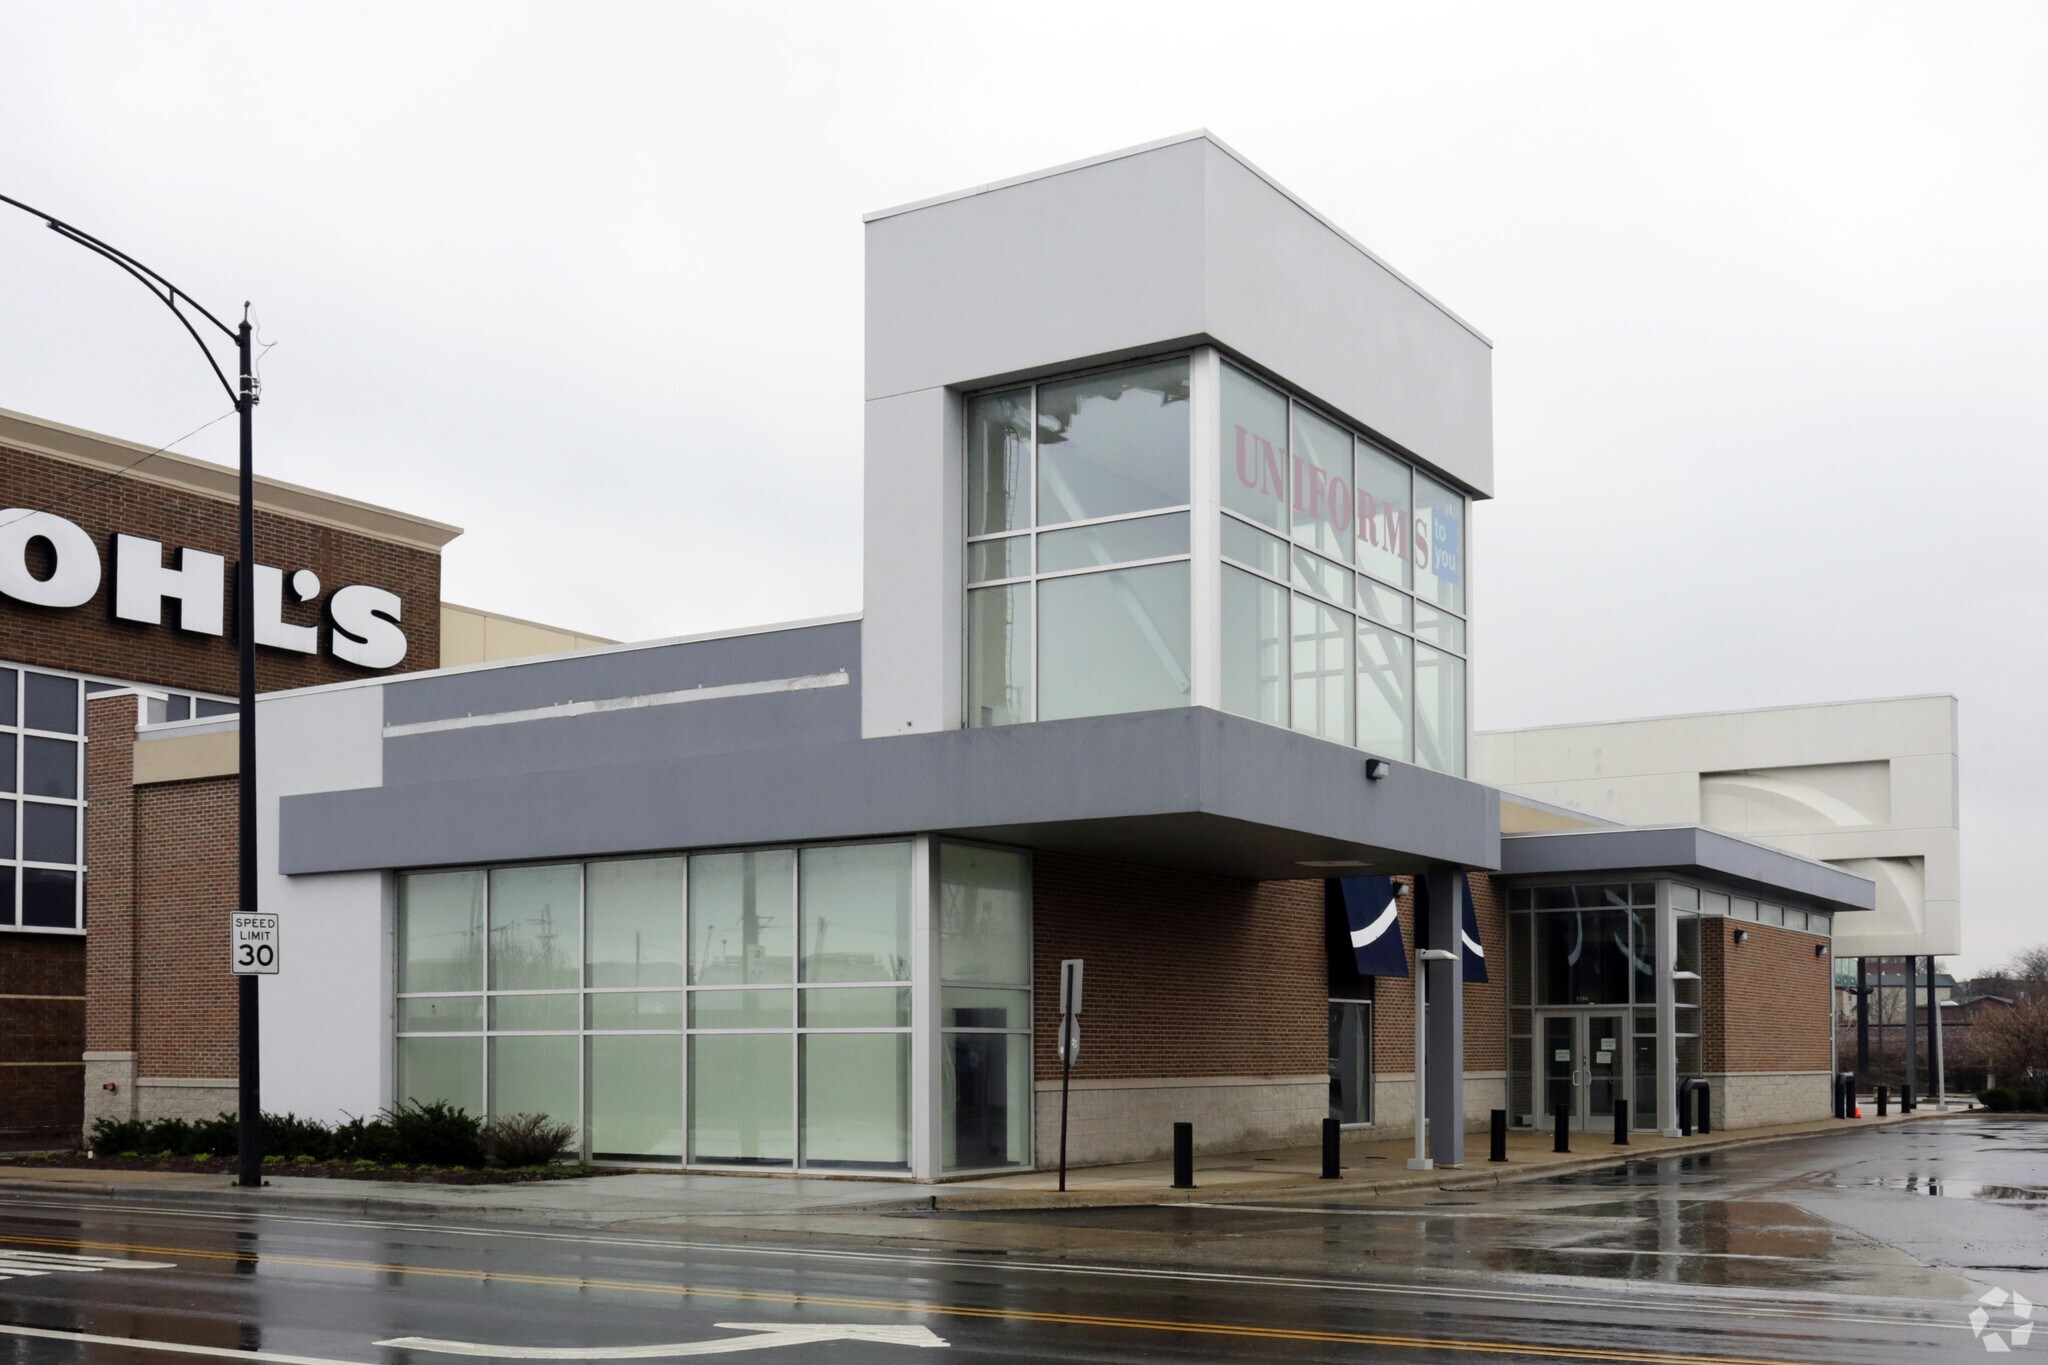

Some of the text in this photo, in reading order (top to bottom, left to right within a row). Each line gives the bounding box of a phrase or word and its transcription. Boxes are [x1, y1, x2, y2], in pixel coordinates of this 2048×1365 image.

[1234, 424, 1429, 570] UNIFORMS
[1434, 516, 1446, 542] to
[1434, 546, 1456, 572] you
[235, 918, 275, 928] SPEED
[240, 931, 271, 940] LIMIT
[238, 944, 273, 966] 30
